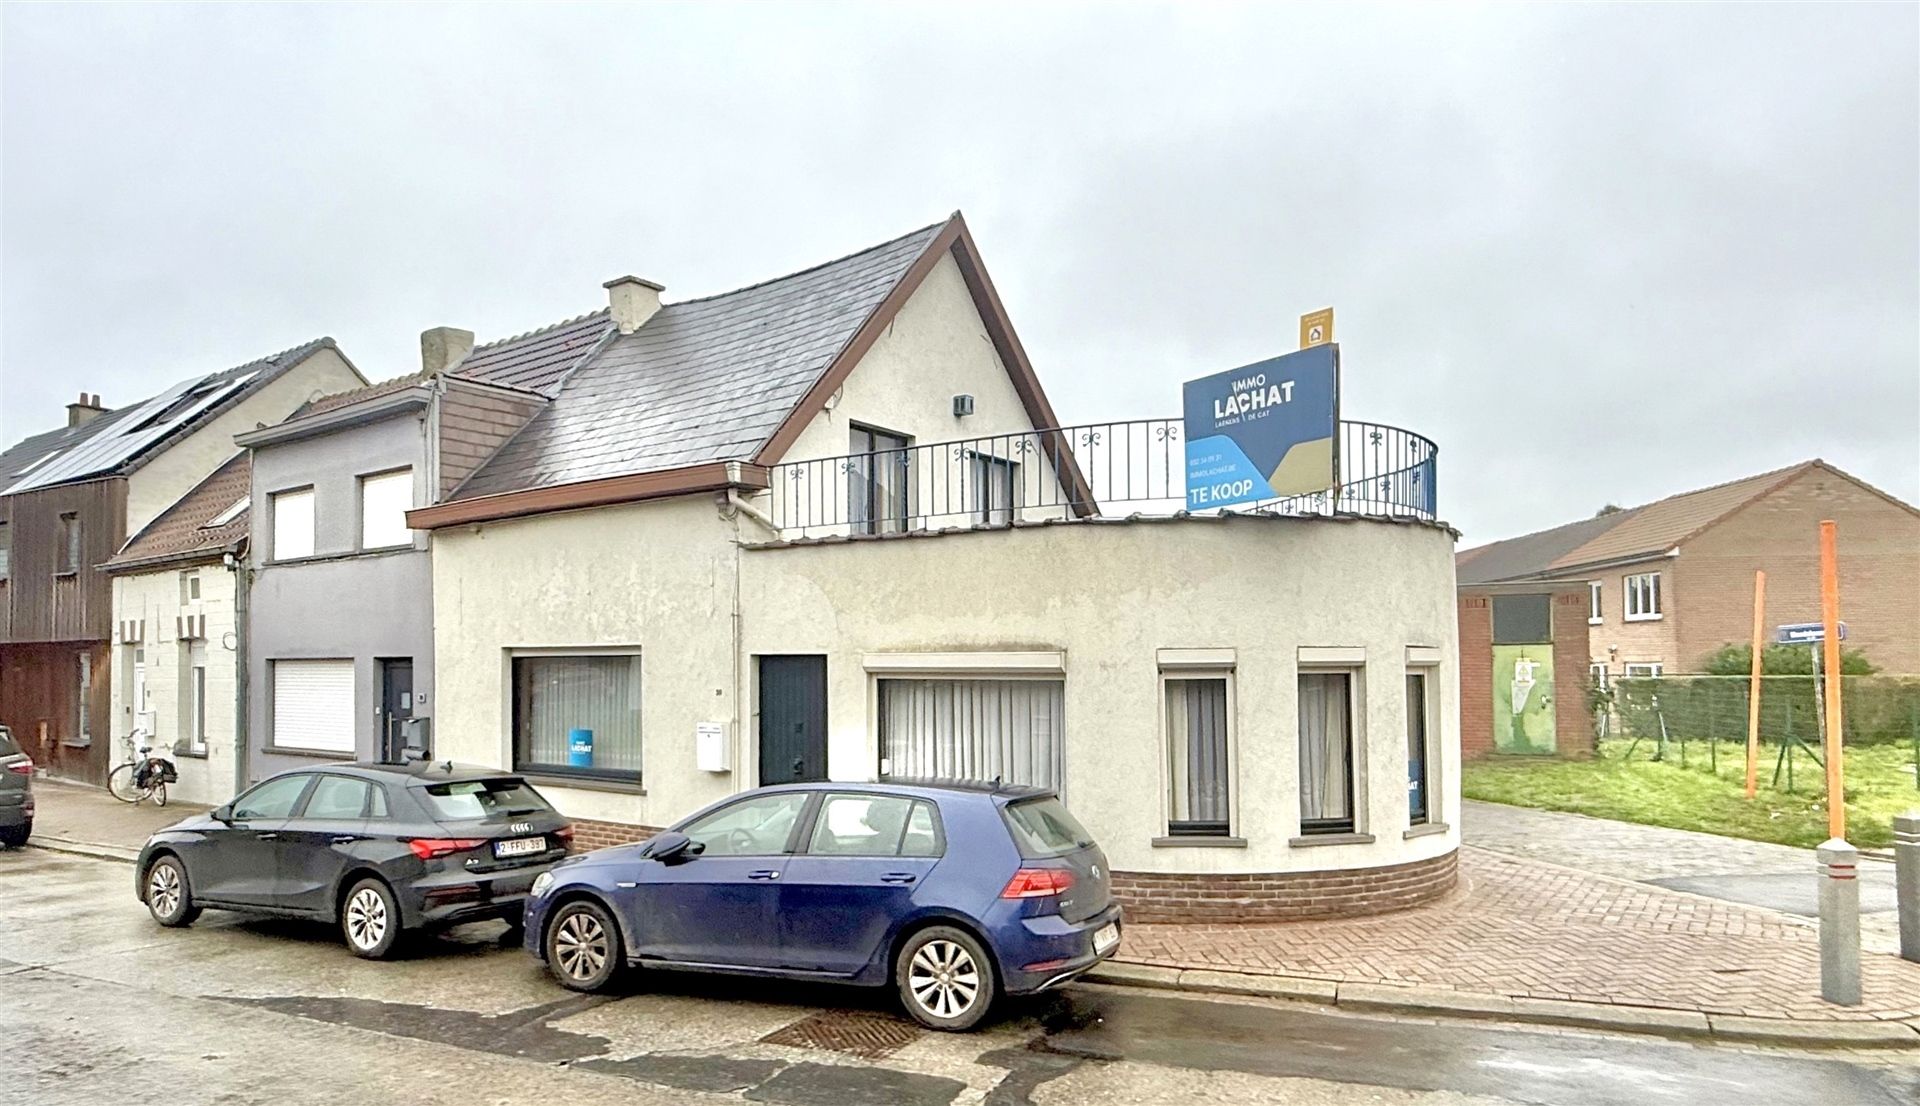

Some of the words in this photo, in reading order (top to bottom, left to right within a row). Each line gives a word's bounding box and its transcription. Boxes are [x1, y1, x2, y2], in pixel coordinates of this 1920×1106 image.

[1232, 374, 1266, 393] IMMO
[1214, 380, 1295, 419] LACHAT
[1257, 410, 1270, 418] CAT
[1190, 486, 1208, 504] TE
[1211, 479, 1253, 501] KOOP
